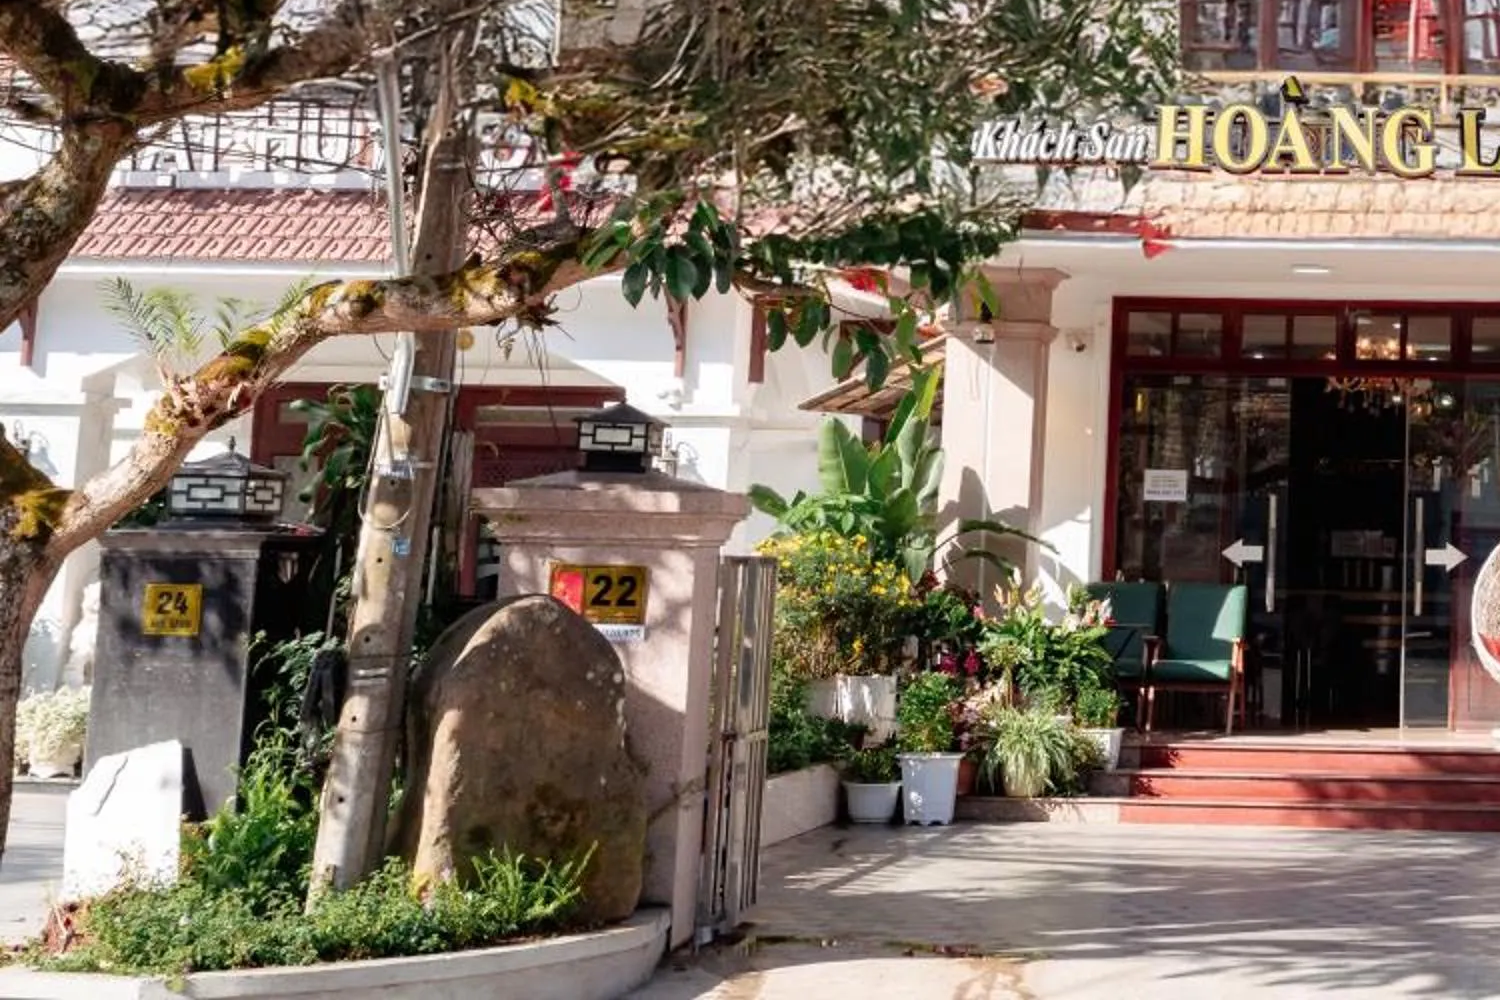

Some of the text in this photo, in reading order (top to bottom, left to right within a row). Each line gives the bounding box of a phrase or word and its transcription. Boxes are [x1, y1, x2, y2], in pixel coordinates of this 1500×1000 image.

[971, 117, 1079, 160] Khách
[1155, 75, 1441, 179] HOÀNG
[156, 591, 188, 615] 24
[590, 574, 637, 607] 22
